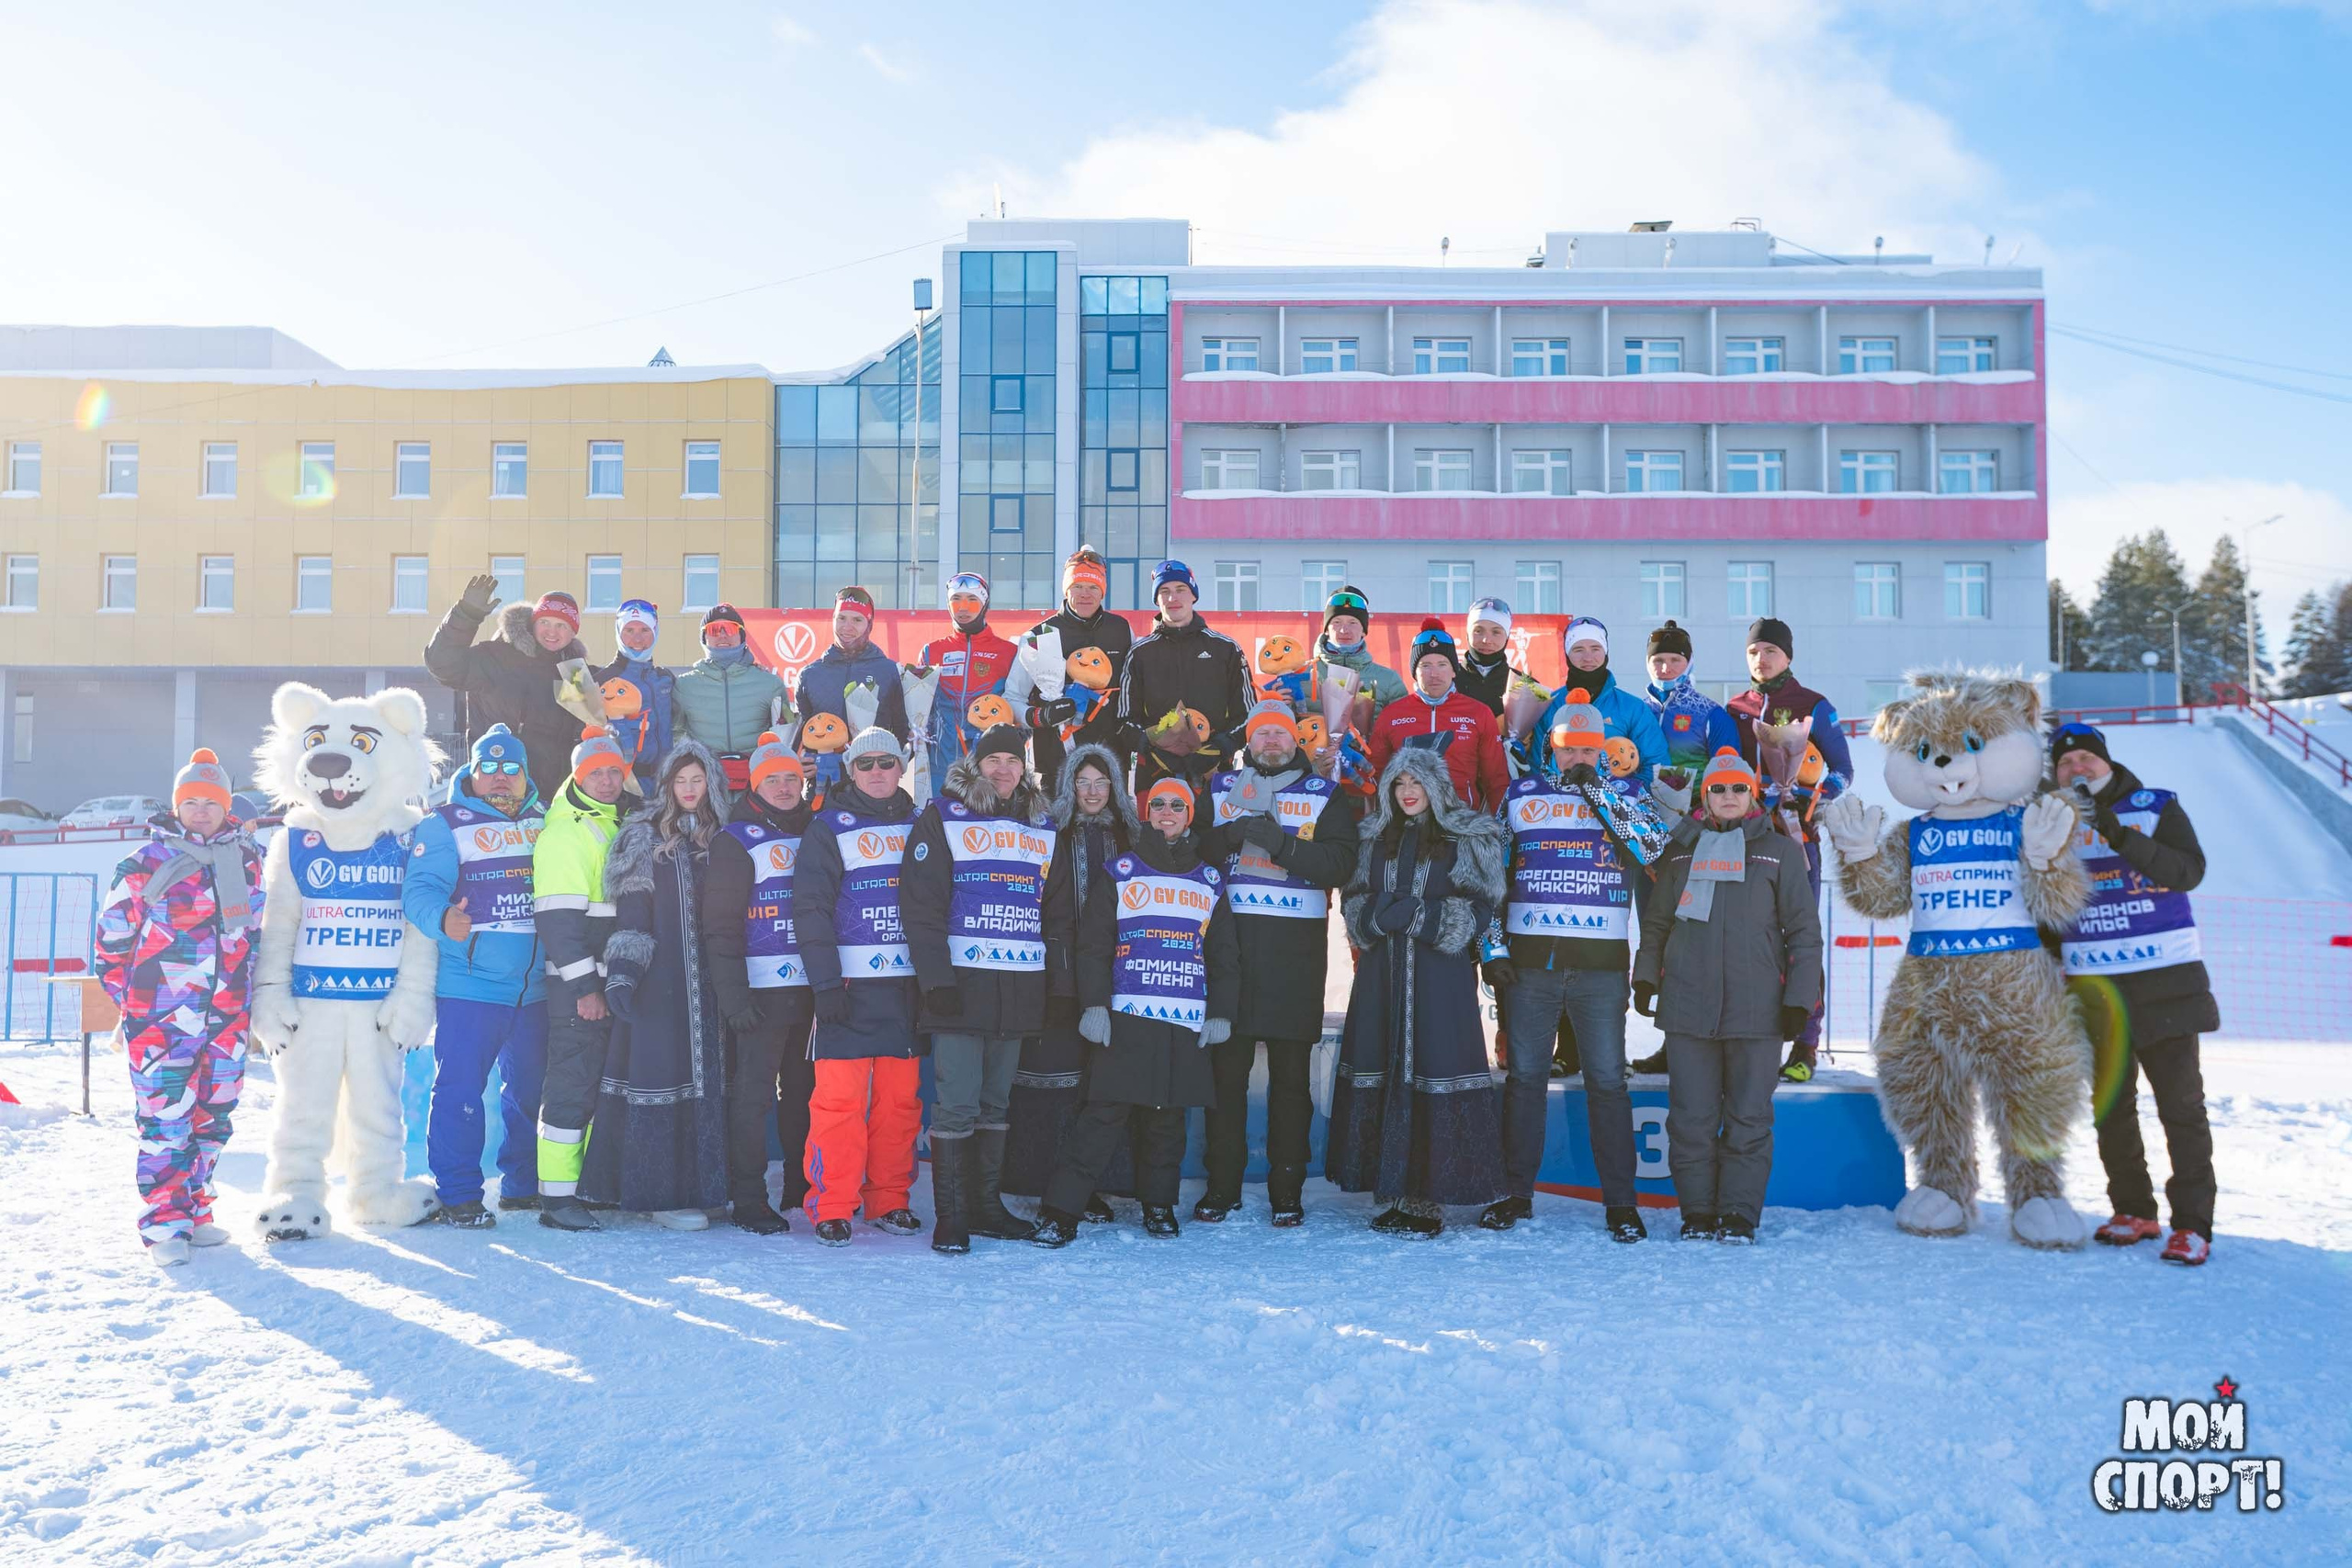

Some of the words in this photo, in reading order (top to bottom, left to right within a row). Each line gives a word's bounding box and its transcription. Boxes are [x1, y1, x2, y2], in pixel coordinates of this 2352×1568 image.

[1391, 716, 1417, 726] BOSCO
[1450, 716, 1476, 725] LUKOIL
[1552, 803, 1575, 818] GV
[504, 829, 524, 846] GV
[886, 835, 905, 852] GV
[994, 830, 1016, 849] GV
[1018, 835, 1048, 855] GOLD
[1946, 829, 1970, 847] GV
[1972, 829, 2013, 847] GOLD
[1557, 849, 1594, 859] 2025
[338, 865, 364, 883] GV
[366, 864, 405, 884] GOLD
[1709, 859, 1744, 873] GOLD
[1006, 881, 1035, 895] 2025
[1527, 881, 1600, 896] МАКСИМ
[1608, 888, 1629, 903] VIP
[1154, 886, 1176, 905] GV
[1178, 888, 1212, 913] GOLD
[1917, 889, 2013, 910] ТРЕНЕР
[747, 905, 779, 919] VIP
[862, 905, 900, 919] АЛЕ
[981, 903, 1040, 920] ШЕДЬКО
[305, 927, 403, 947] ТРЕНЕР
[1161, 938, 1194, 951] 2025
[1125, 958, 1205, 977] ФОМИЧЕВА
[1141, 971, 1194, 988] ЕЛЕНА
[1631, 1105, 1672, 1179] 3
